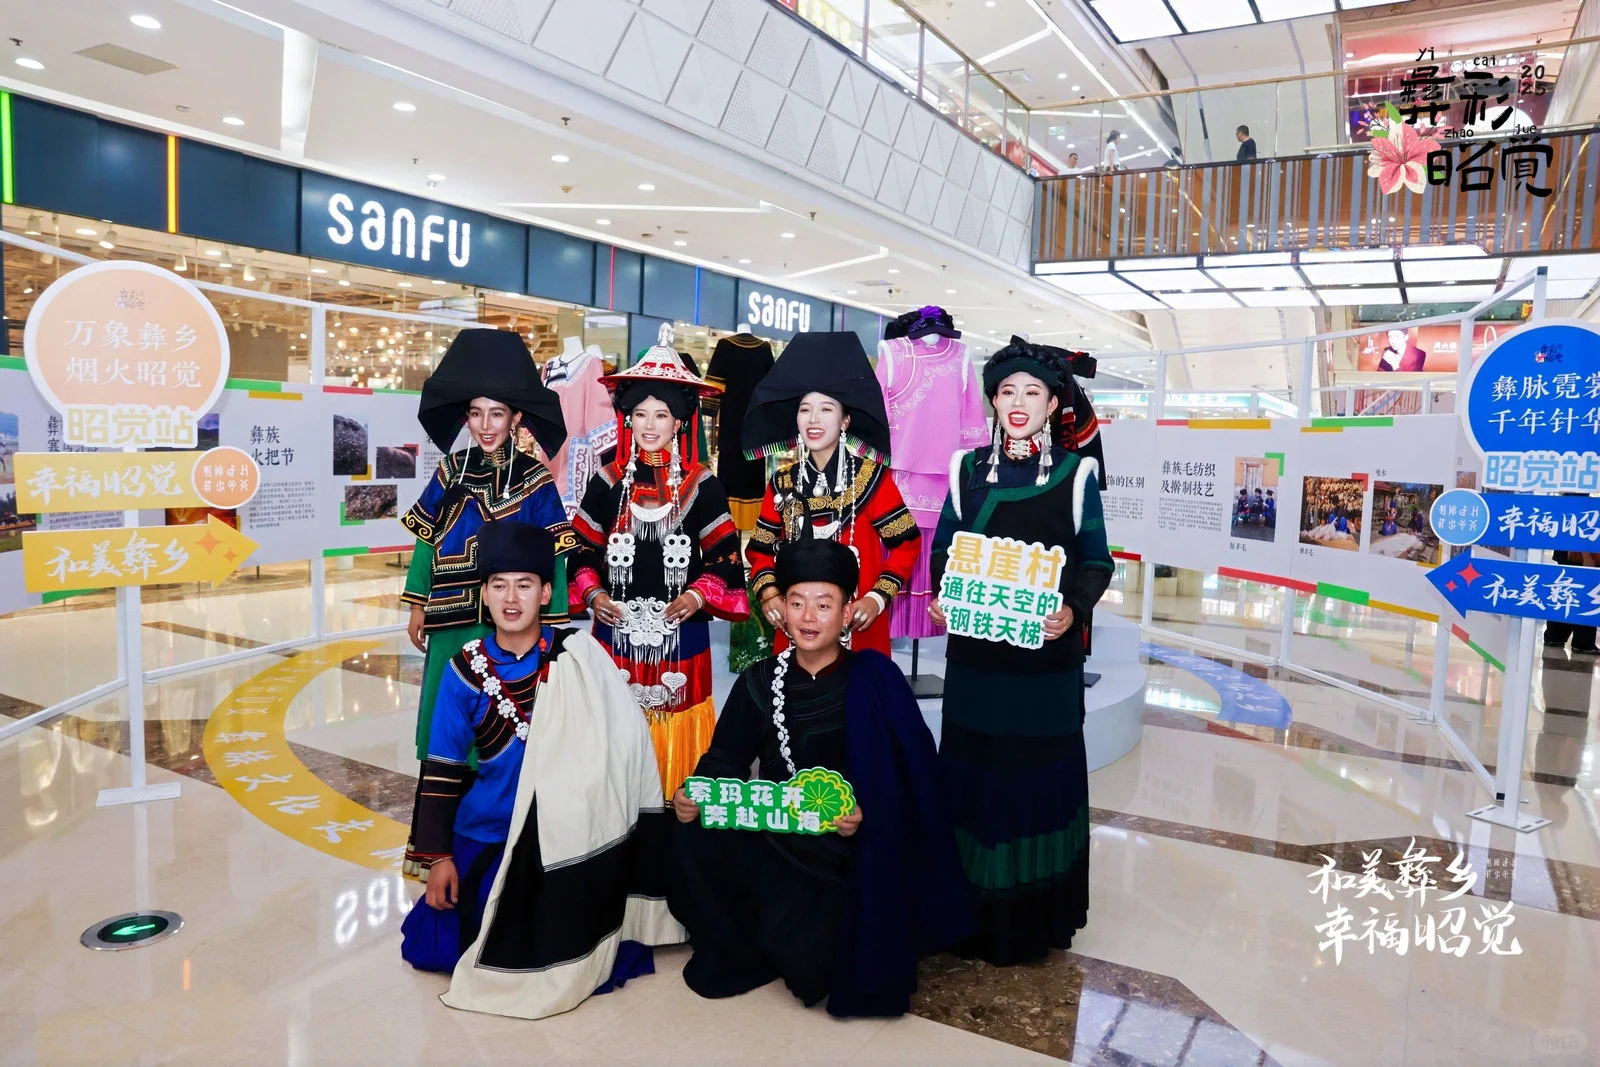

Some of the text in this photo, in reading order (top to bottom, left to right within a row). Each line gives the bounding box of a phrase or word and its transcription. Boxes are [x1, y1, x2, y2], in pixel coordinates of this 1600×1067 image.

[64, 319, 198, 352] 万象彝乡
[65, 357, 202, 389] 烟火昭觉
[67, 408, 194, 445] 昭觉站
[250, 425, 280, 445] 彝族
[251, 448, 294, 466] 火把节
[1161, 460, 1216, 477] 彝族毛纺织
[1485, 454, 1600, 491] 昭觉站
[26, 462, 184, 507] 幸福昭觉
[44, 530, 190, 584] 和美彝乡
[949, 535, 1062, 589] 悬崖村
[942, 576, 1059, 616] 通往天空的
[688, 781, 805, 808] 索玛花开
[704, 805, 820, 832] 奔赴山海
